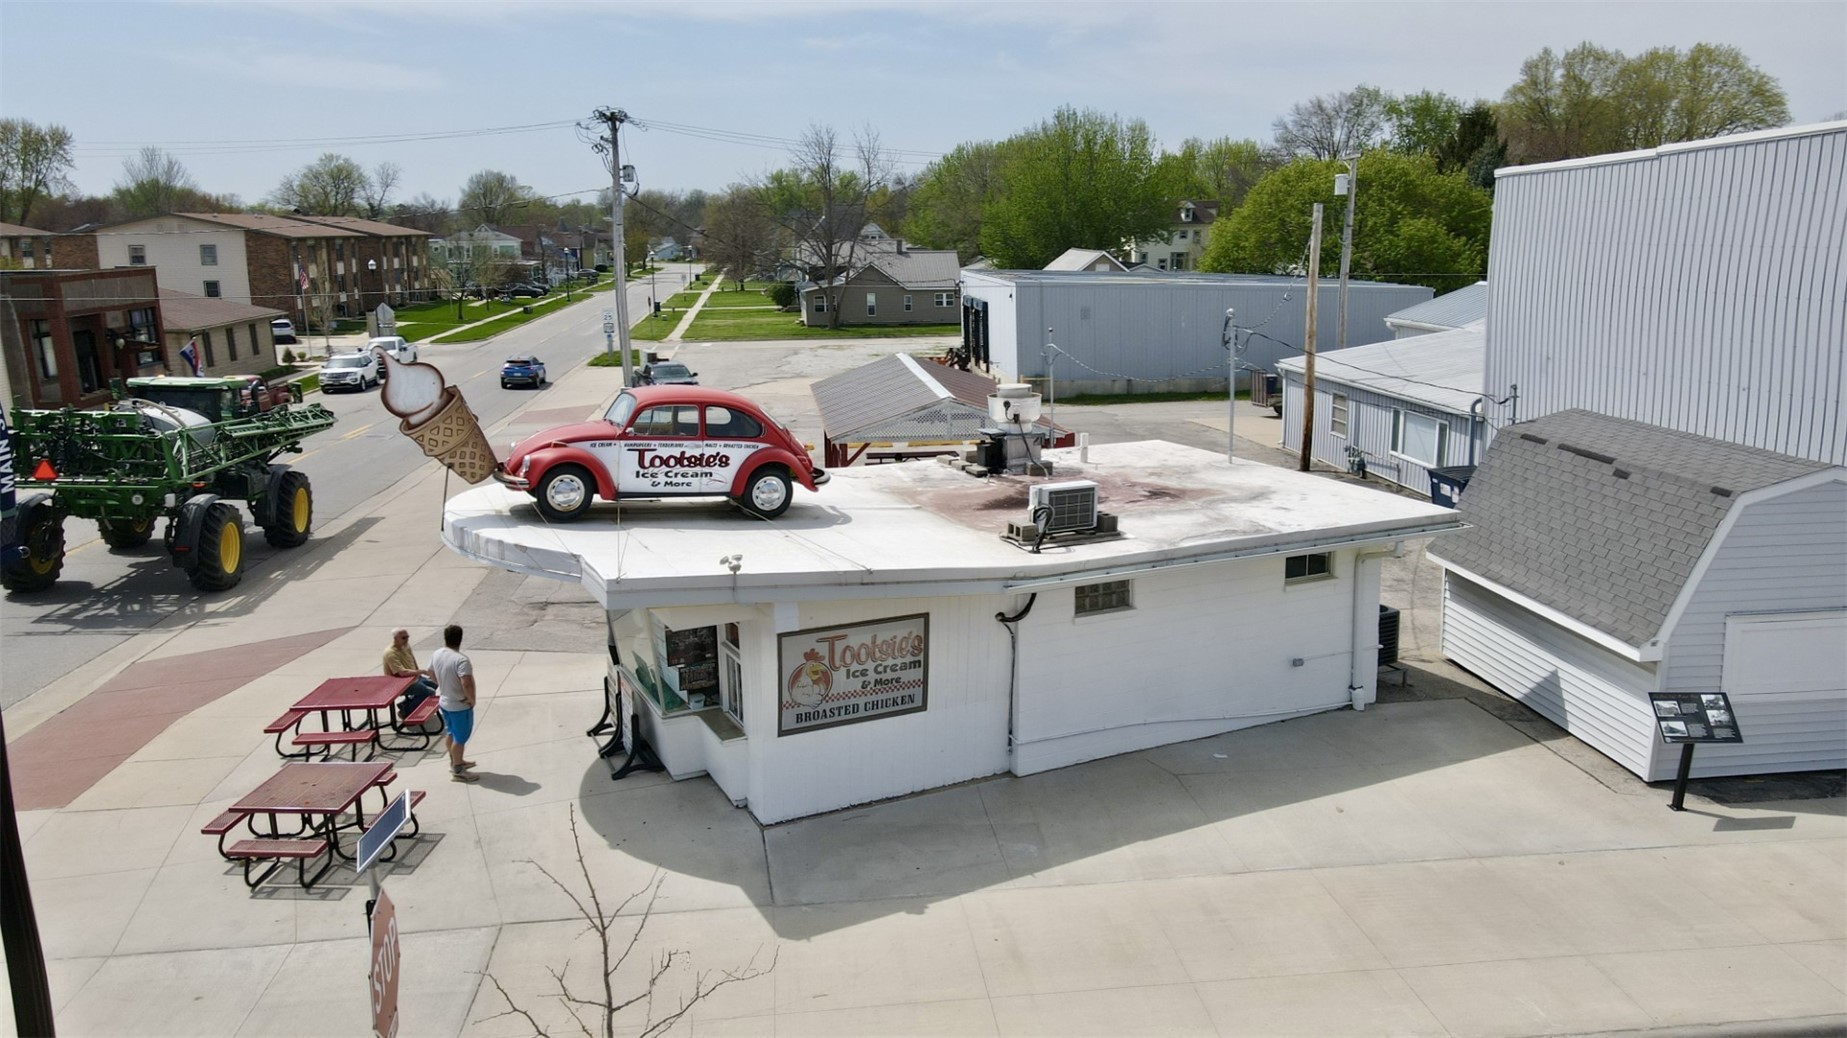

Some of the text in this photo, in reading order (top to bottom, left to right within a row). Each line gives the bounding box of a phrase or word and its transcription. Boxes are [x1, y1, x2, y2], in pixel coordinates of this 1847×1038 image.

[0, 438, 15, 494] MAIN
[627, 448, 731, 470] Tootsie's
[635, 470, 713, 479] Ice Cream
[816, 631, 924, 671] Tootsie's
[845, 659, 922, 680] Ice Cream
[861, 675, 902, 690] & More
[795, 693, 916, 724] BROASTED CHICKEN
[373, 917, 397, 1015] STOP
